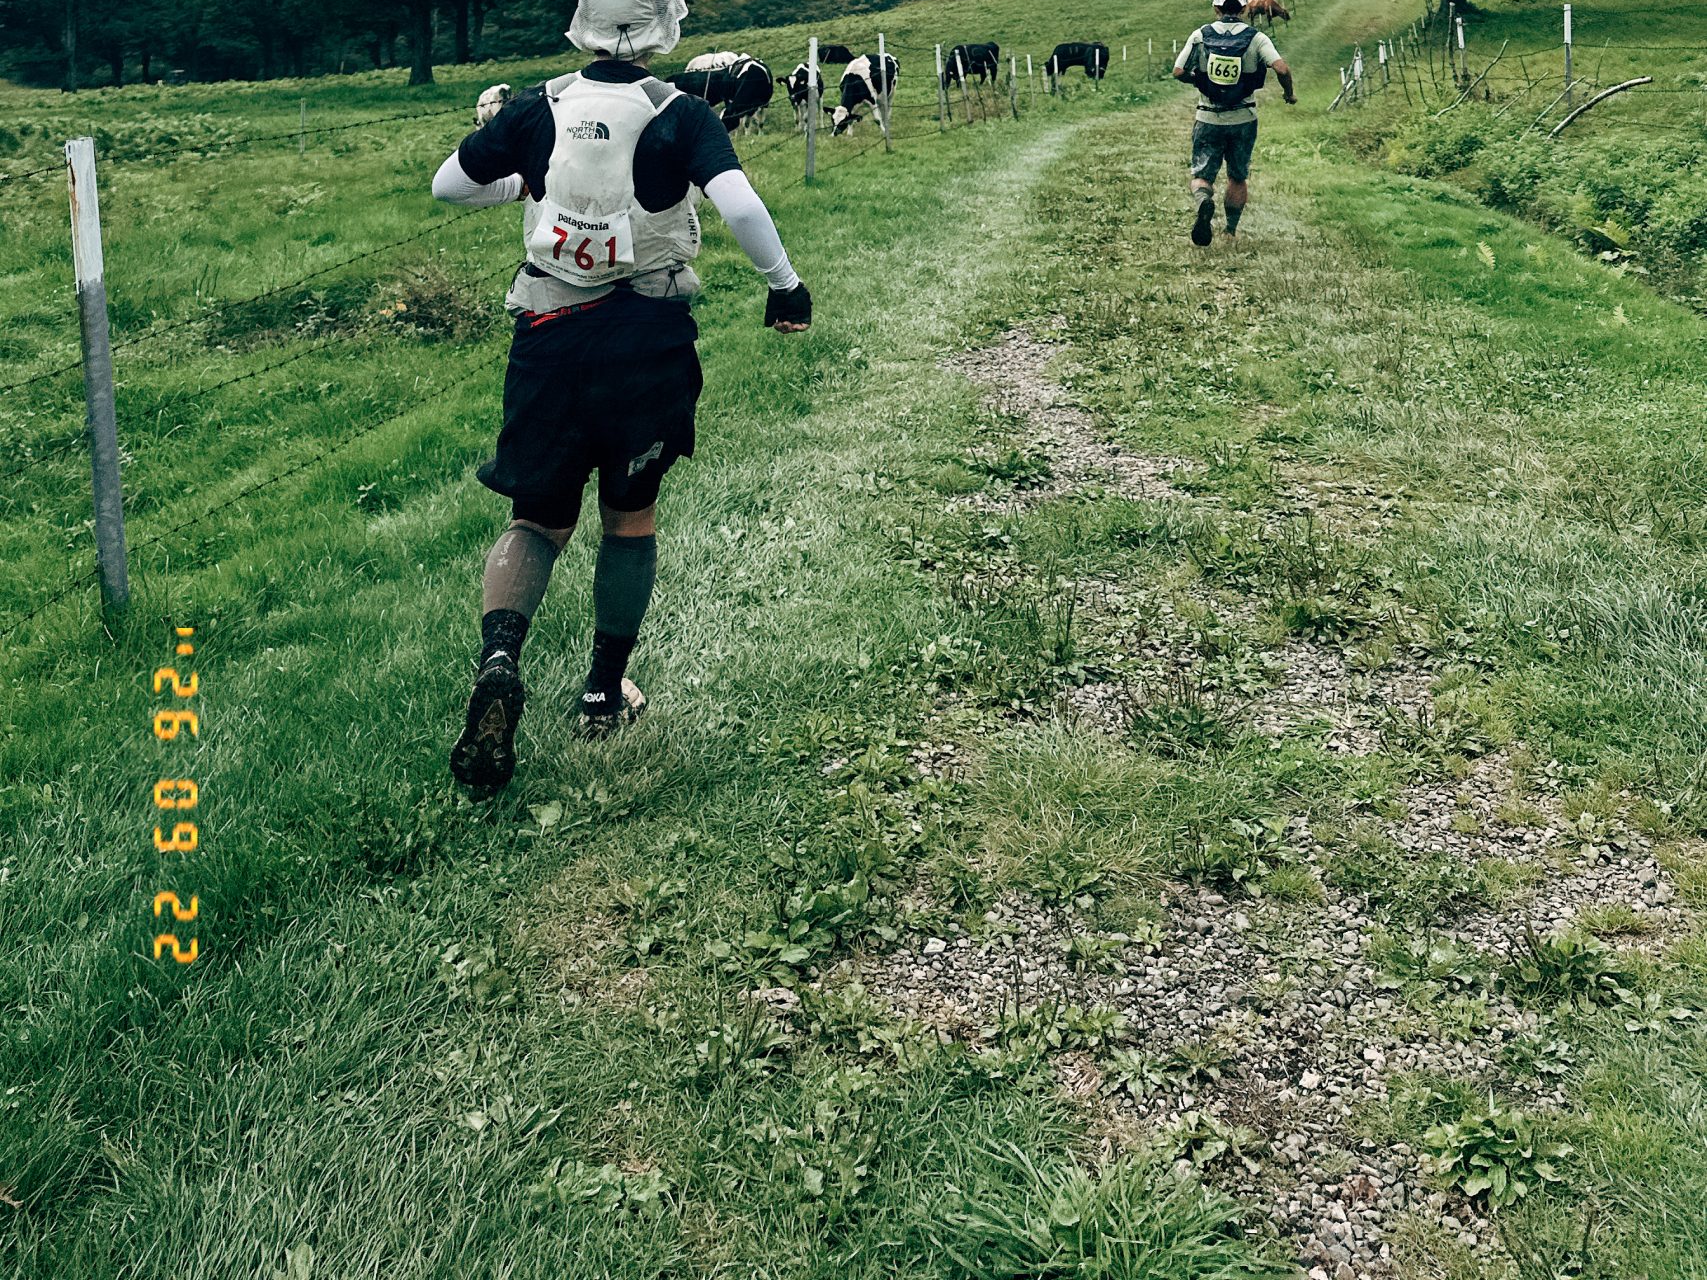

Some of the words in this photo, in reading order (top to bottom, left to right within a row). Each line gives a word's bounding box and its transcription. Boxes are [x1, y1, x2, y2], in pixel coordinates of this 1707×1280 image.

[1210, 62, 1238, 78] 1663
[566, 126, 595, 134] NORTH
[572, 132, 593, 140] FACE
[557, 212, 610, 231] patagonia
[552, 225, 617, 271] 761
